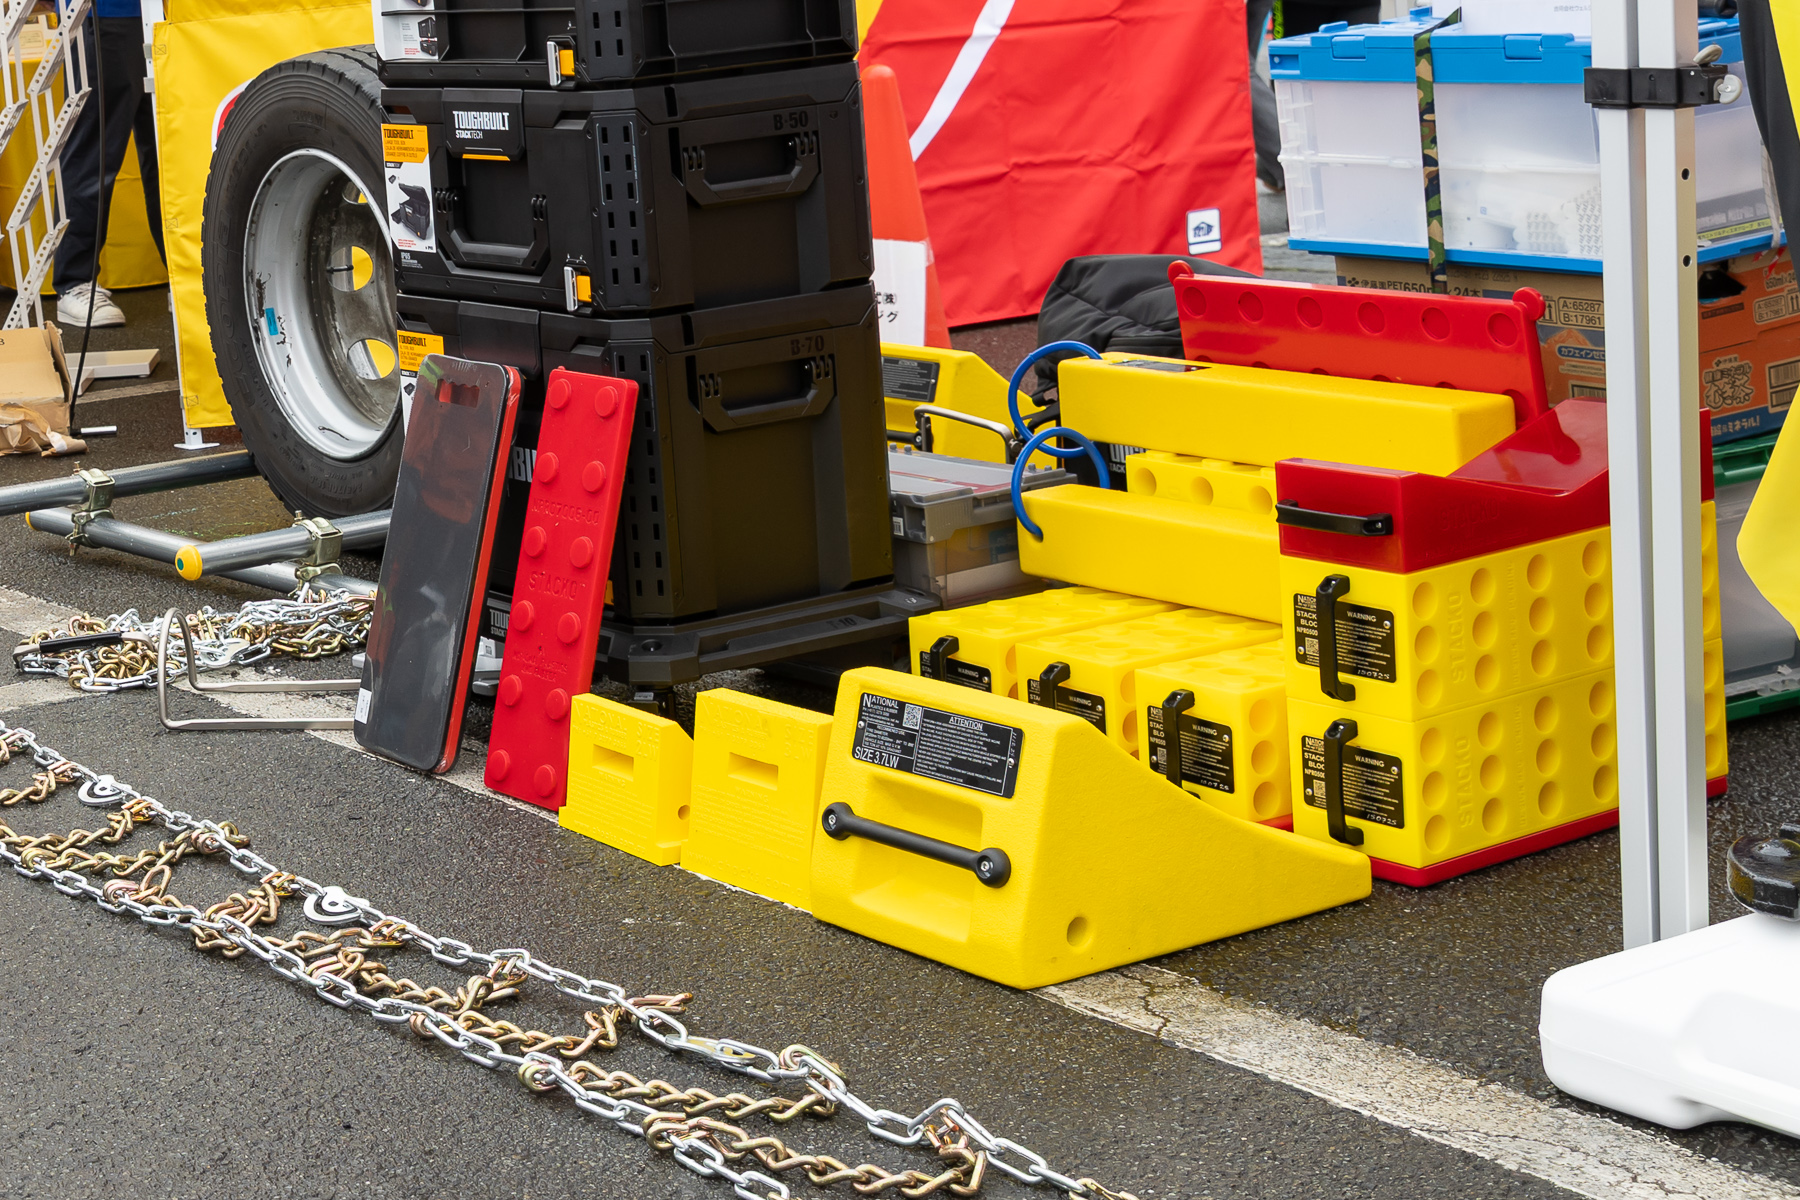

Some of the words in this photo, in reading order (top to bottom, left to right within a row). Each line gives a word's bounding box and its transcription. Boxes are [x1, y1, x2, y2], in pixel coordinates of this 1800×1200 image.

[453, 111, 510, 131] TOUGHBUILT
[383, 128, 414, 139] TOUGHBUILT
[455, 130, 483, 139] STACKTECH
[1561, 300, 1602, 314] A:65287
[1563, 312, 1602, 326] B:17961
[1347, 611, 1377, 622] WARNING
[1448, 591, 1468, 685] STACKO
[863, 693, 899, 709] NATIONAL
[1069, 695, 1092, 707] WARNING
[949, 716, 983, 731] ATTENTION
[1192, 724, 1218, 736] WARNING
[854, 746, 875, 763] SIZE
[874, 751, 900, 769] 3.7LW
[1355, 754, 1385, 768] WARNING
[1455, 735, 1475, 829] STACKO
